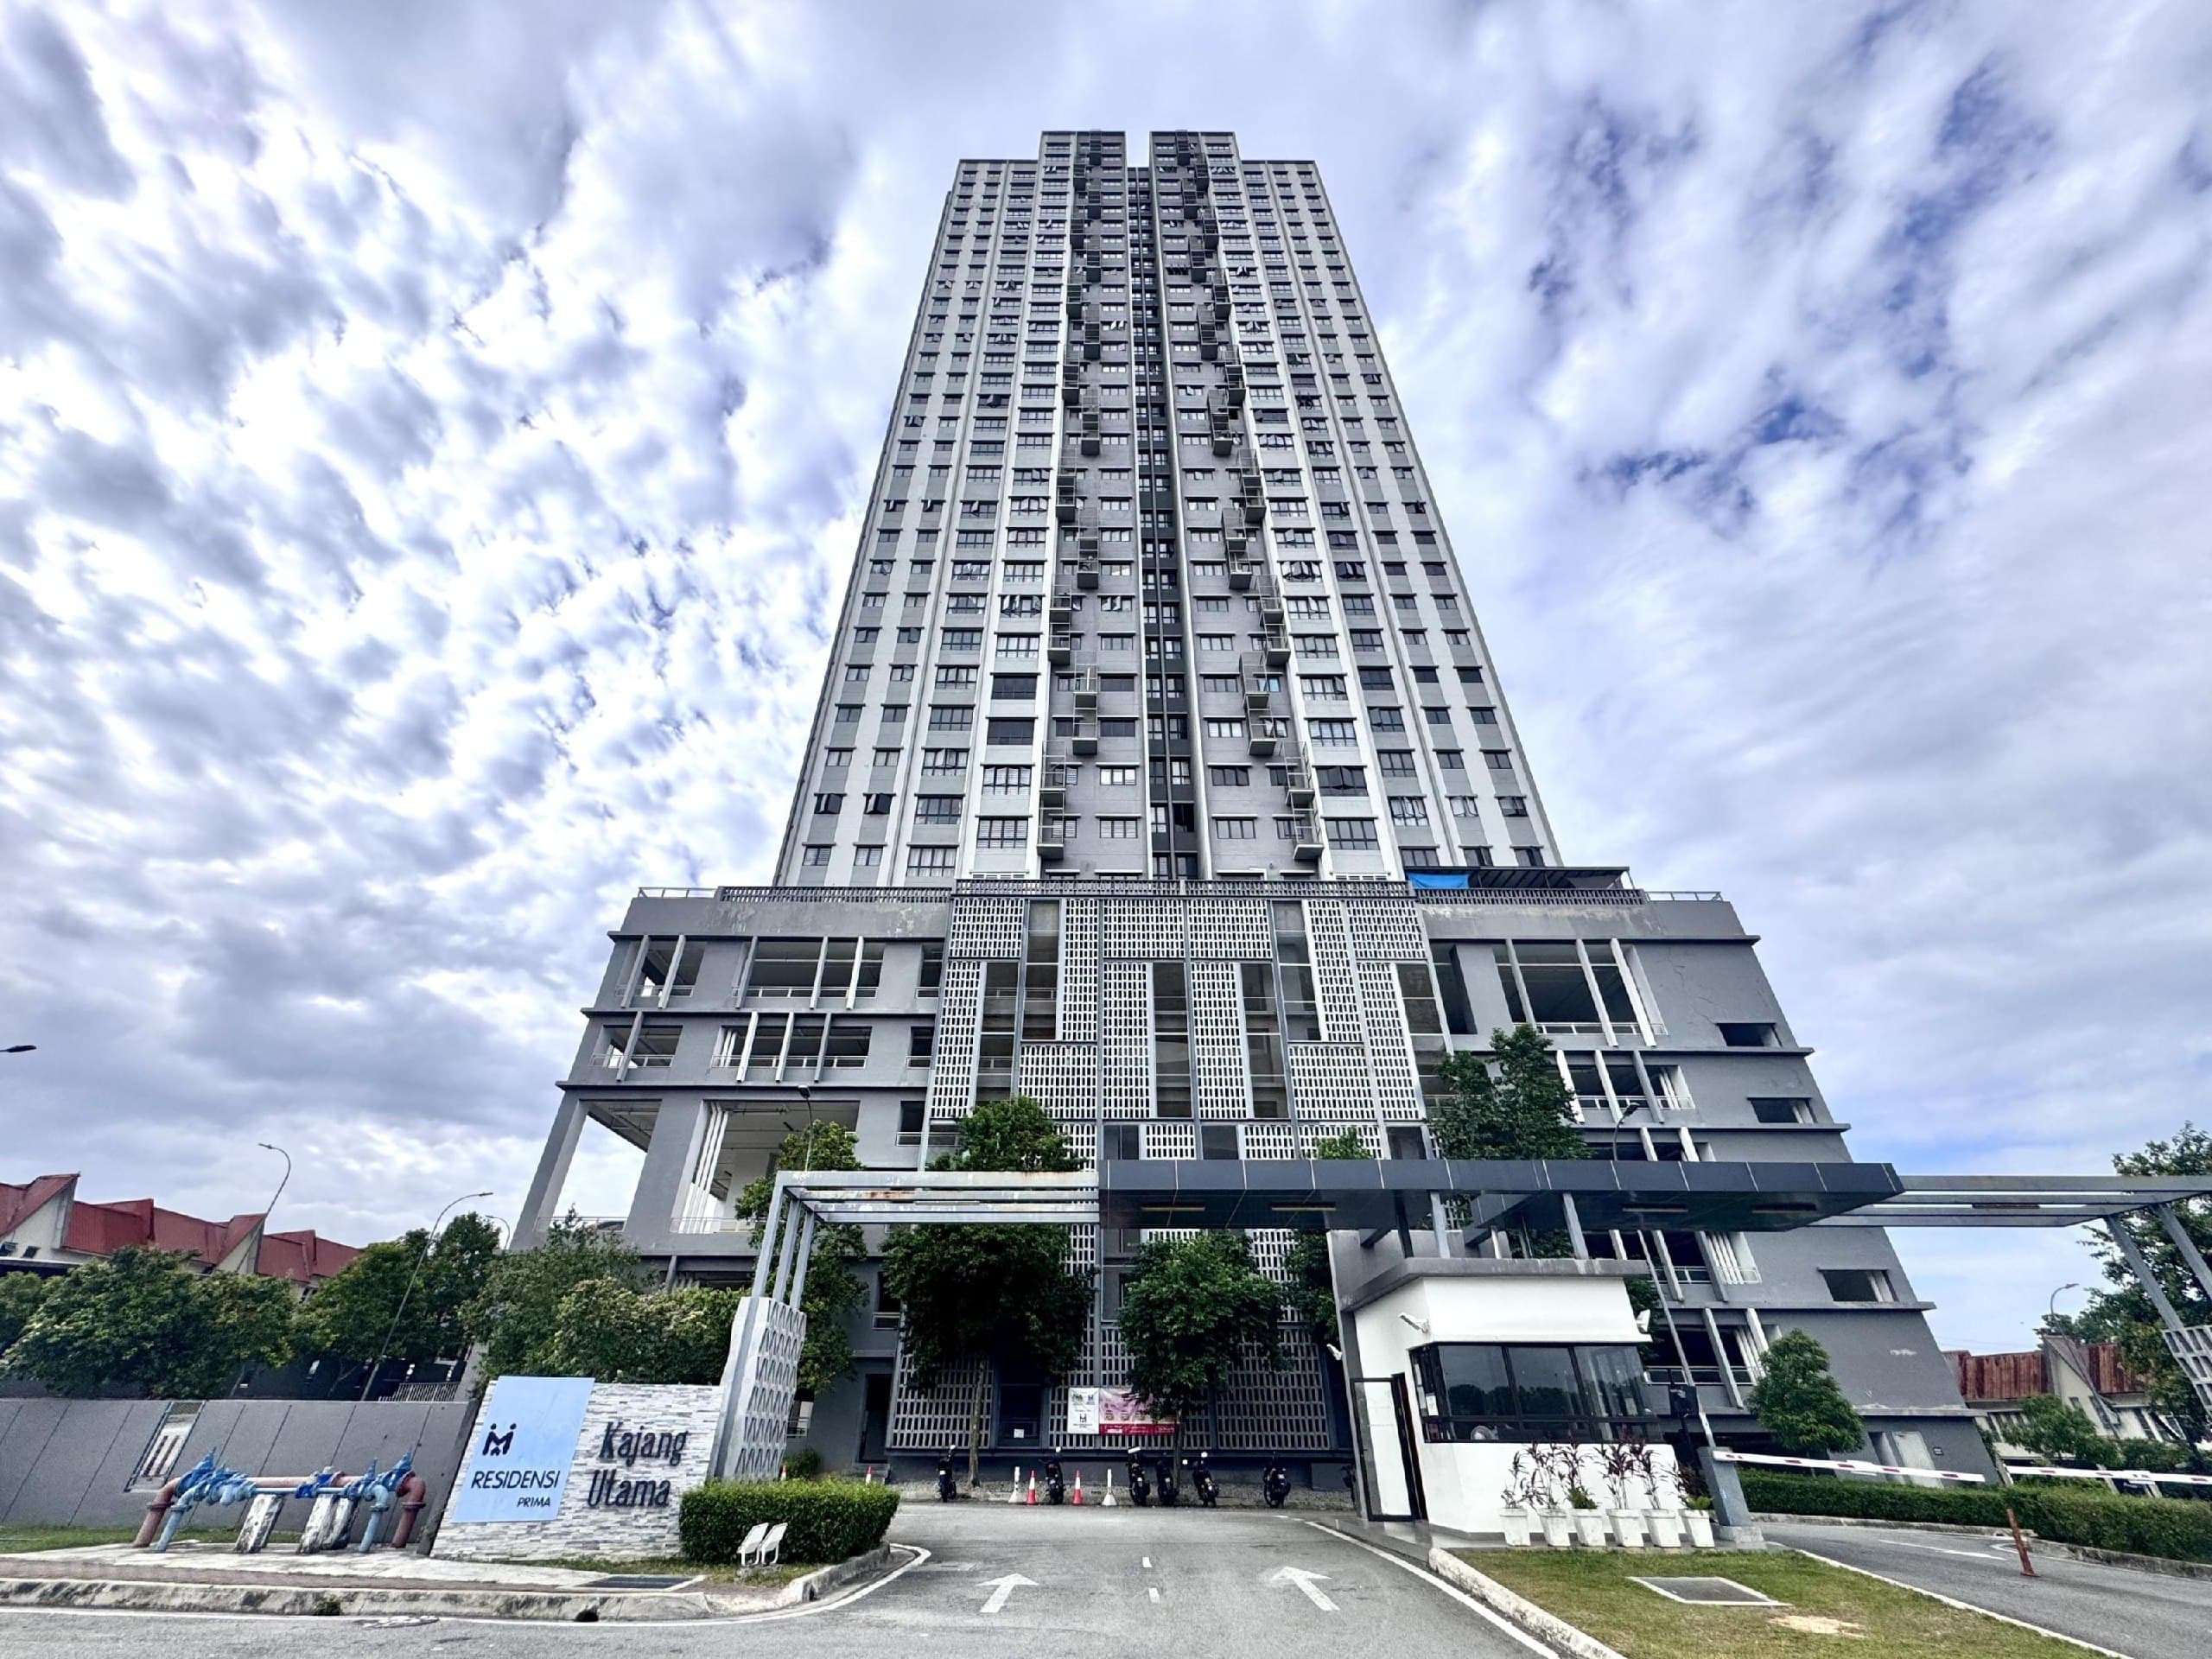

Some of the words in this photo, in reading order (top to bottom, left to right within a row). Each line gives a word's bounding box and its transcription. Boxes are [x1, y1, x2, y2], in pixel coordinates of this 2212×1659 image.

[599, 1421, 689, 1466] Kajang
[472, 1471, 560, 1489] RESIDENSI
[588, 1469, 671, 1507] Utama
